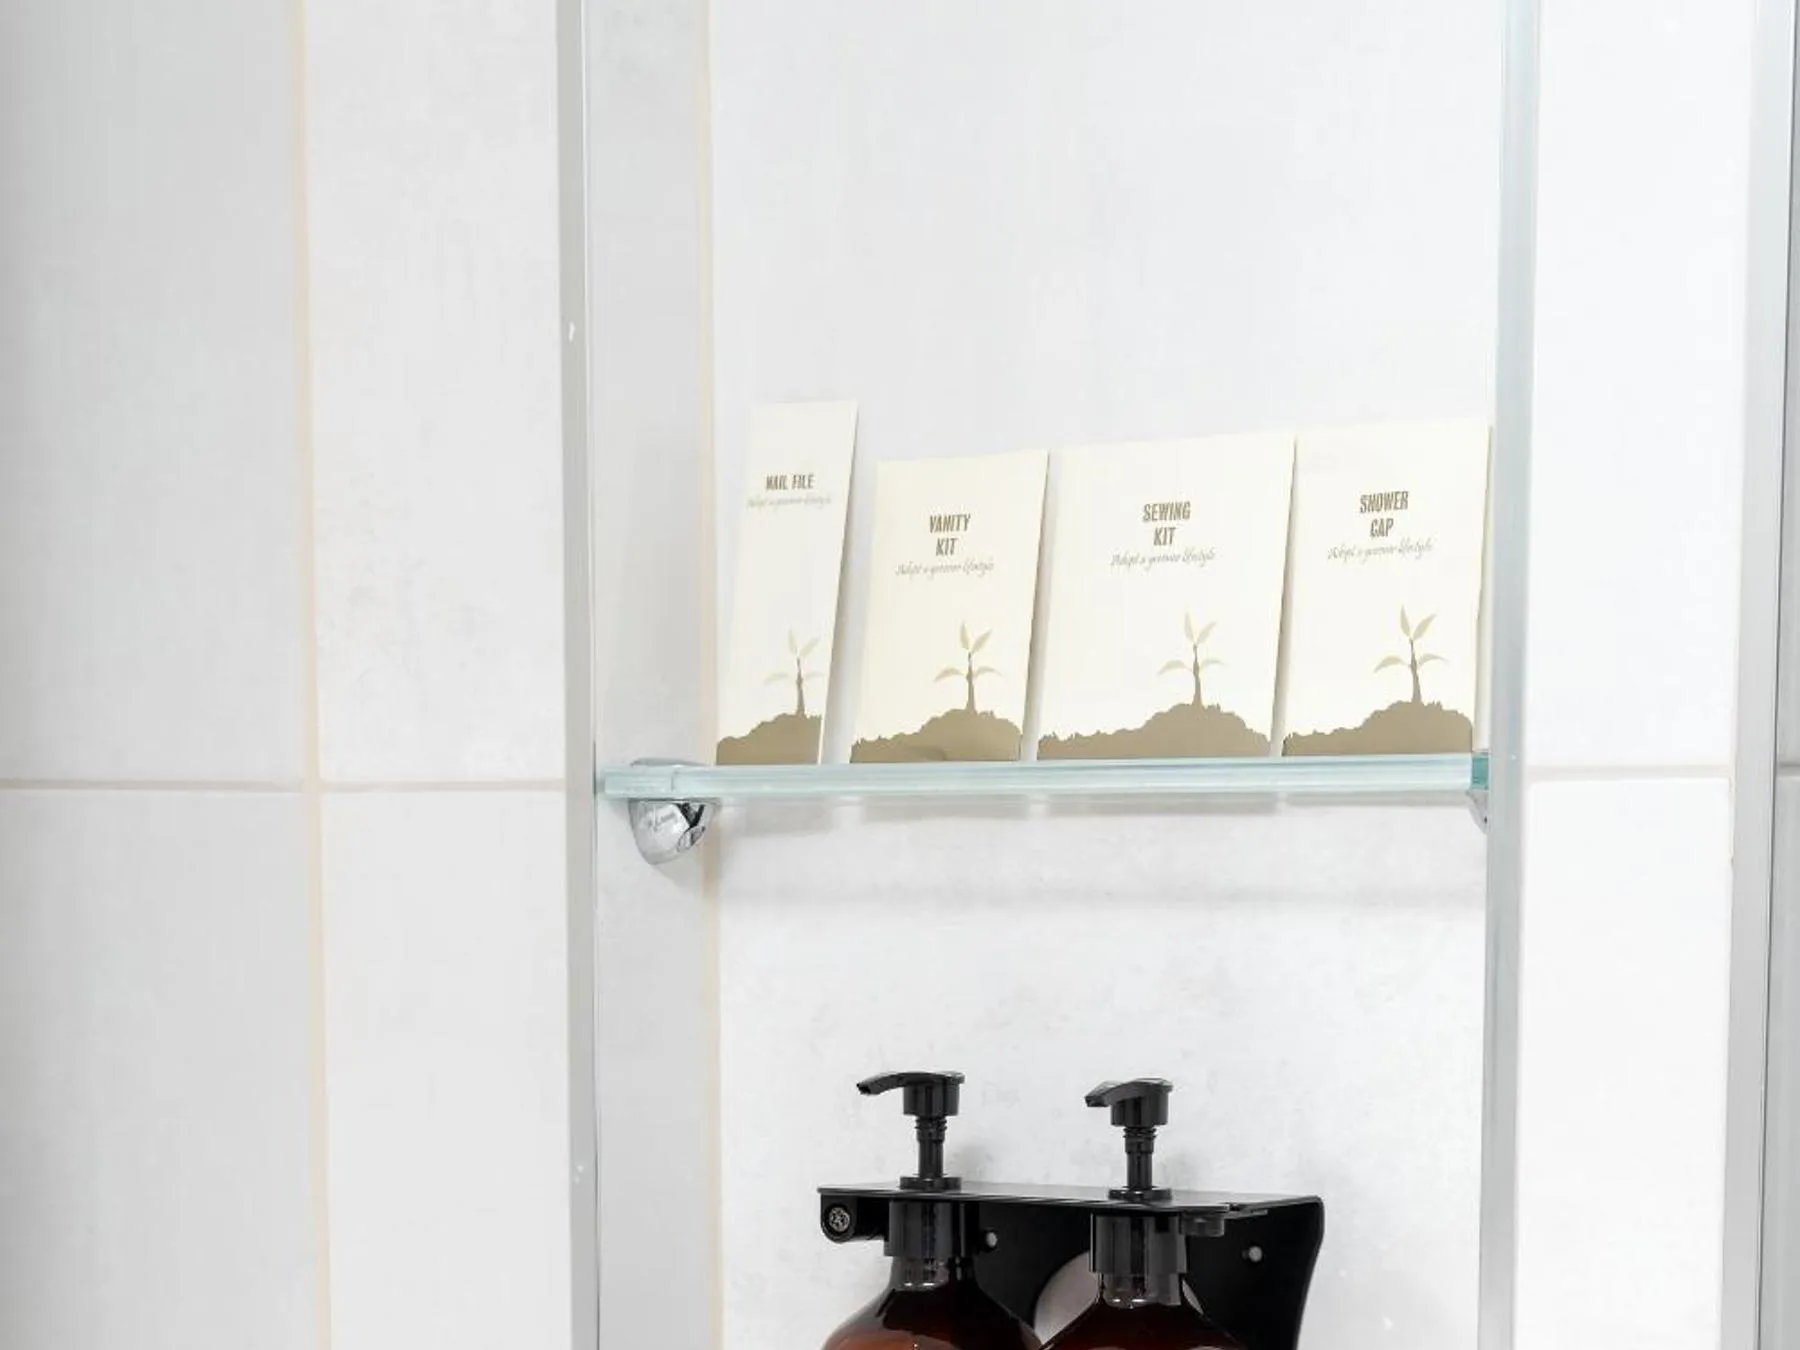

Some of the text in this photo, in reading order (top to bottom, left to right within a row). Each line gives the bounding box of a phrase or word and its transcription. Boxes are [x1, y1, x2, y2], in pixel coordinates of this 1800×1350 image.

[766, 472, 815, 490] NAIL FILE
[1142, 500, 1191, 522] SEWING
[1360, 490, 1409, 513] SHOWER
[929, 513, 971, 533] VANITY
[1369, 517, 1394, 537] CAP
[1153, 526, 1176, 546] KIT
[935, 537, 959, 556] KIT
